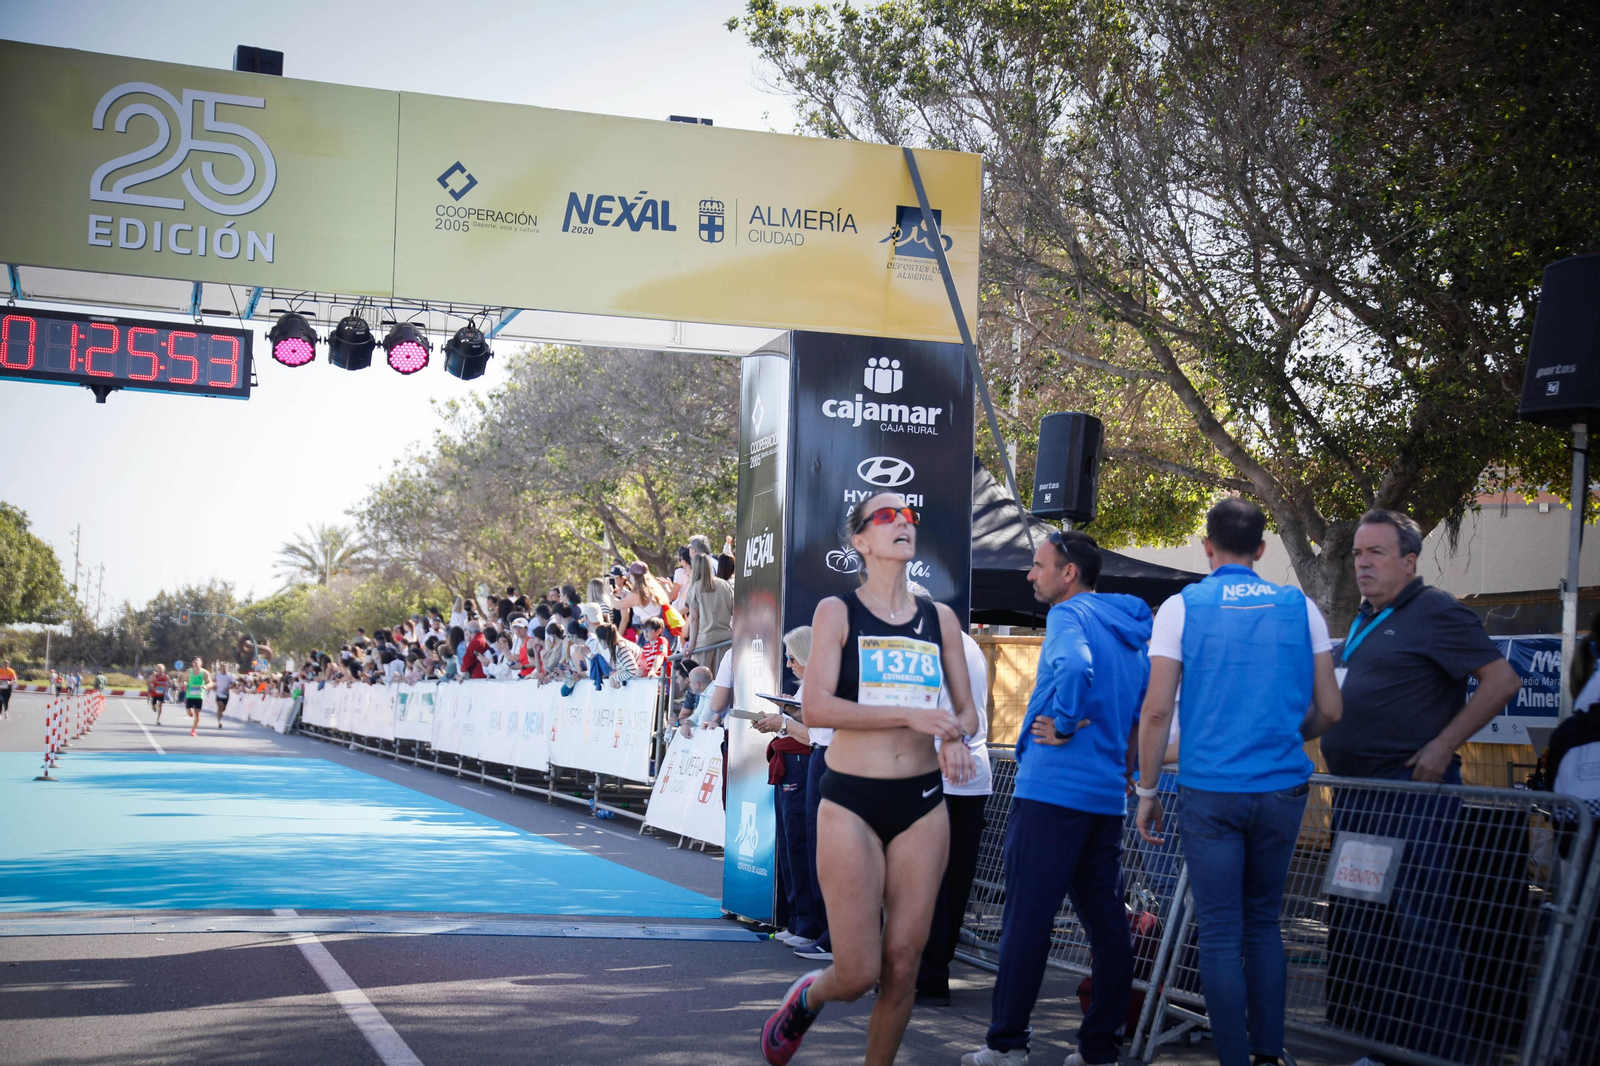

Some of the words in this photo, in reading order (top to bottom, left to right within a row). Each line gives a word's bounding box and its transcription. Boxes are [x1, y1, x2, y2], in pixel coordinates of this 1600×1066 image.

[90, 81, 277, 216] 25
[435, 204, 537, 227] COOPERACIÓN
[562, 191, 677, 233] NEXAL
[749, 205, 859, 234] ALMERÍA
[435, 218, 470, 232] 2005
[571, 226, 594, 235] 2020
[88, 214, 275, 263] EDICIÓN
[748, 229, 805, 246] CIUDAD
[886, 262, 930, 273] DEPORTES
[0, 314, 239, 389] 01:25:53
[822, 393, 942, 427] cajamar
[880, 423, 905, 433] CAJA
[907, 425, 938, 436] RURAL
[844, 489, 924, 507] HYAI
[1223, 582, 1277, 600] NEXAL
[870, 649, 936, 677] 1378
[882, 672, 925, 683] ESTHERCITA
[1541, 676, 1561, 686] Mara
[1516, 687, 1560, 708] Almer
[1336, 866, 1383, 886] EVENTOS
